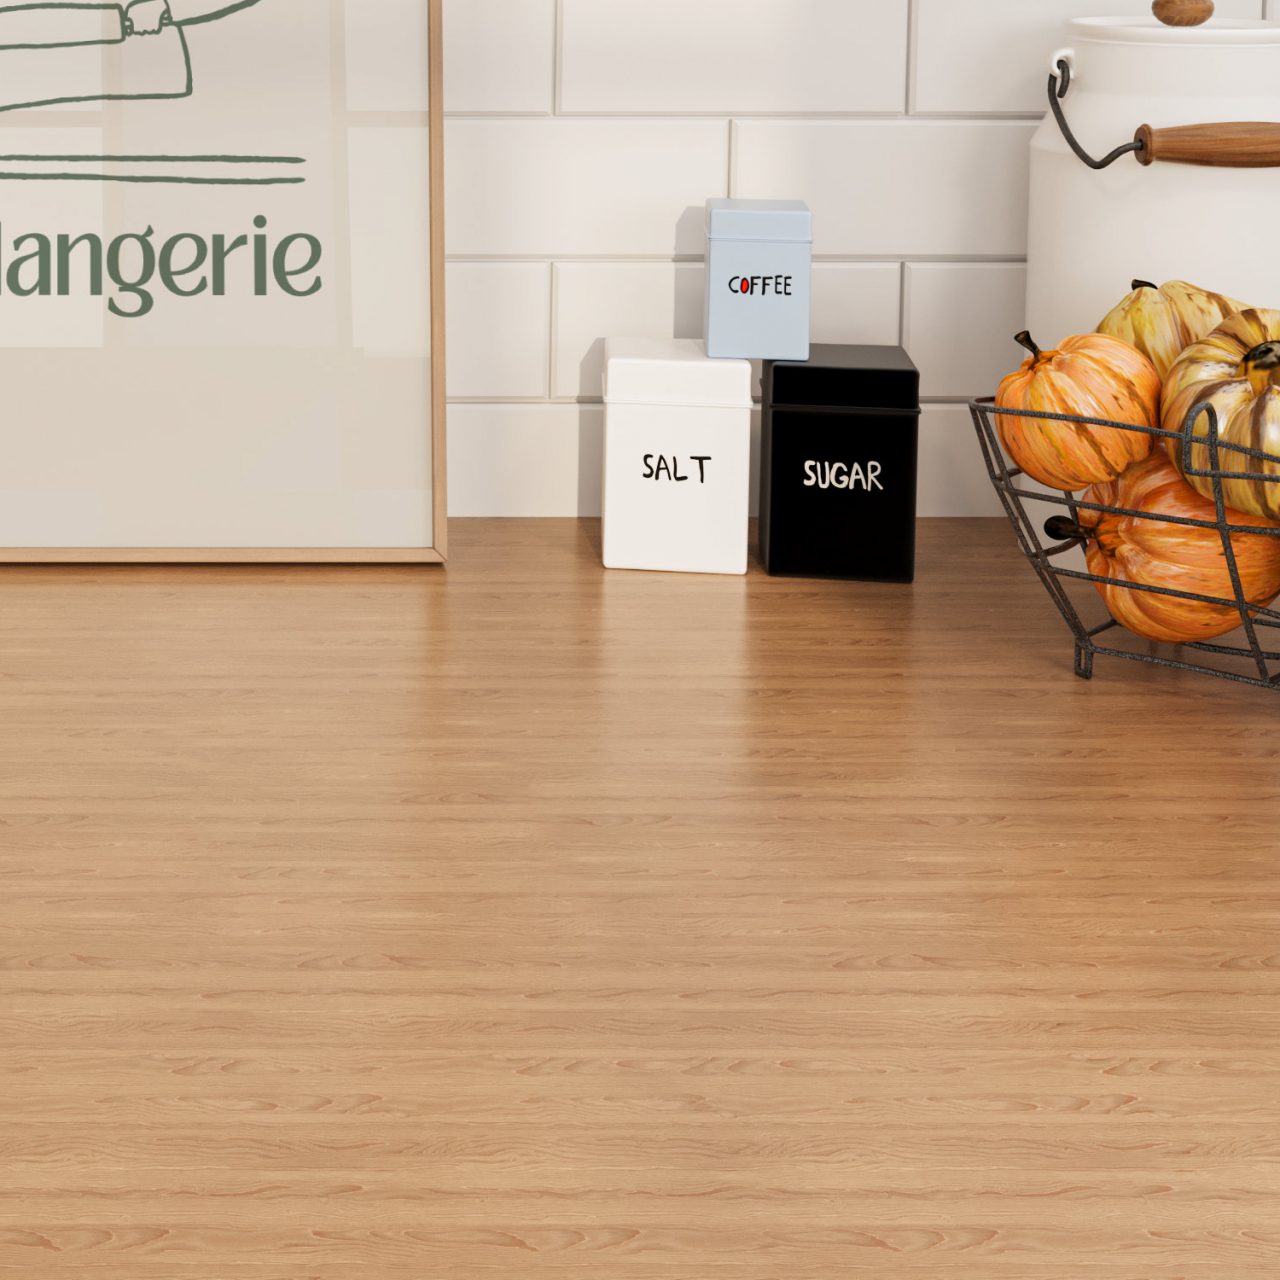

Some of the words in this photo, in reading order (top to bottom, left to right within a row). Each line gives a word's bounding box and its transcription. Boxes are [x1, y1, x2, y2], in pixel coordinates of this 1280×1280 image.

[728, 275, 792, 295] COFFEE
[643, 454, 711, 483] SALT
[803, 460, 884, 491] SUGAR
